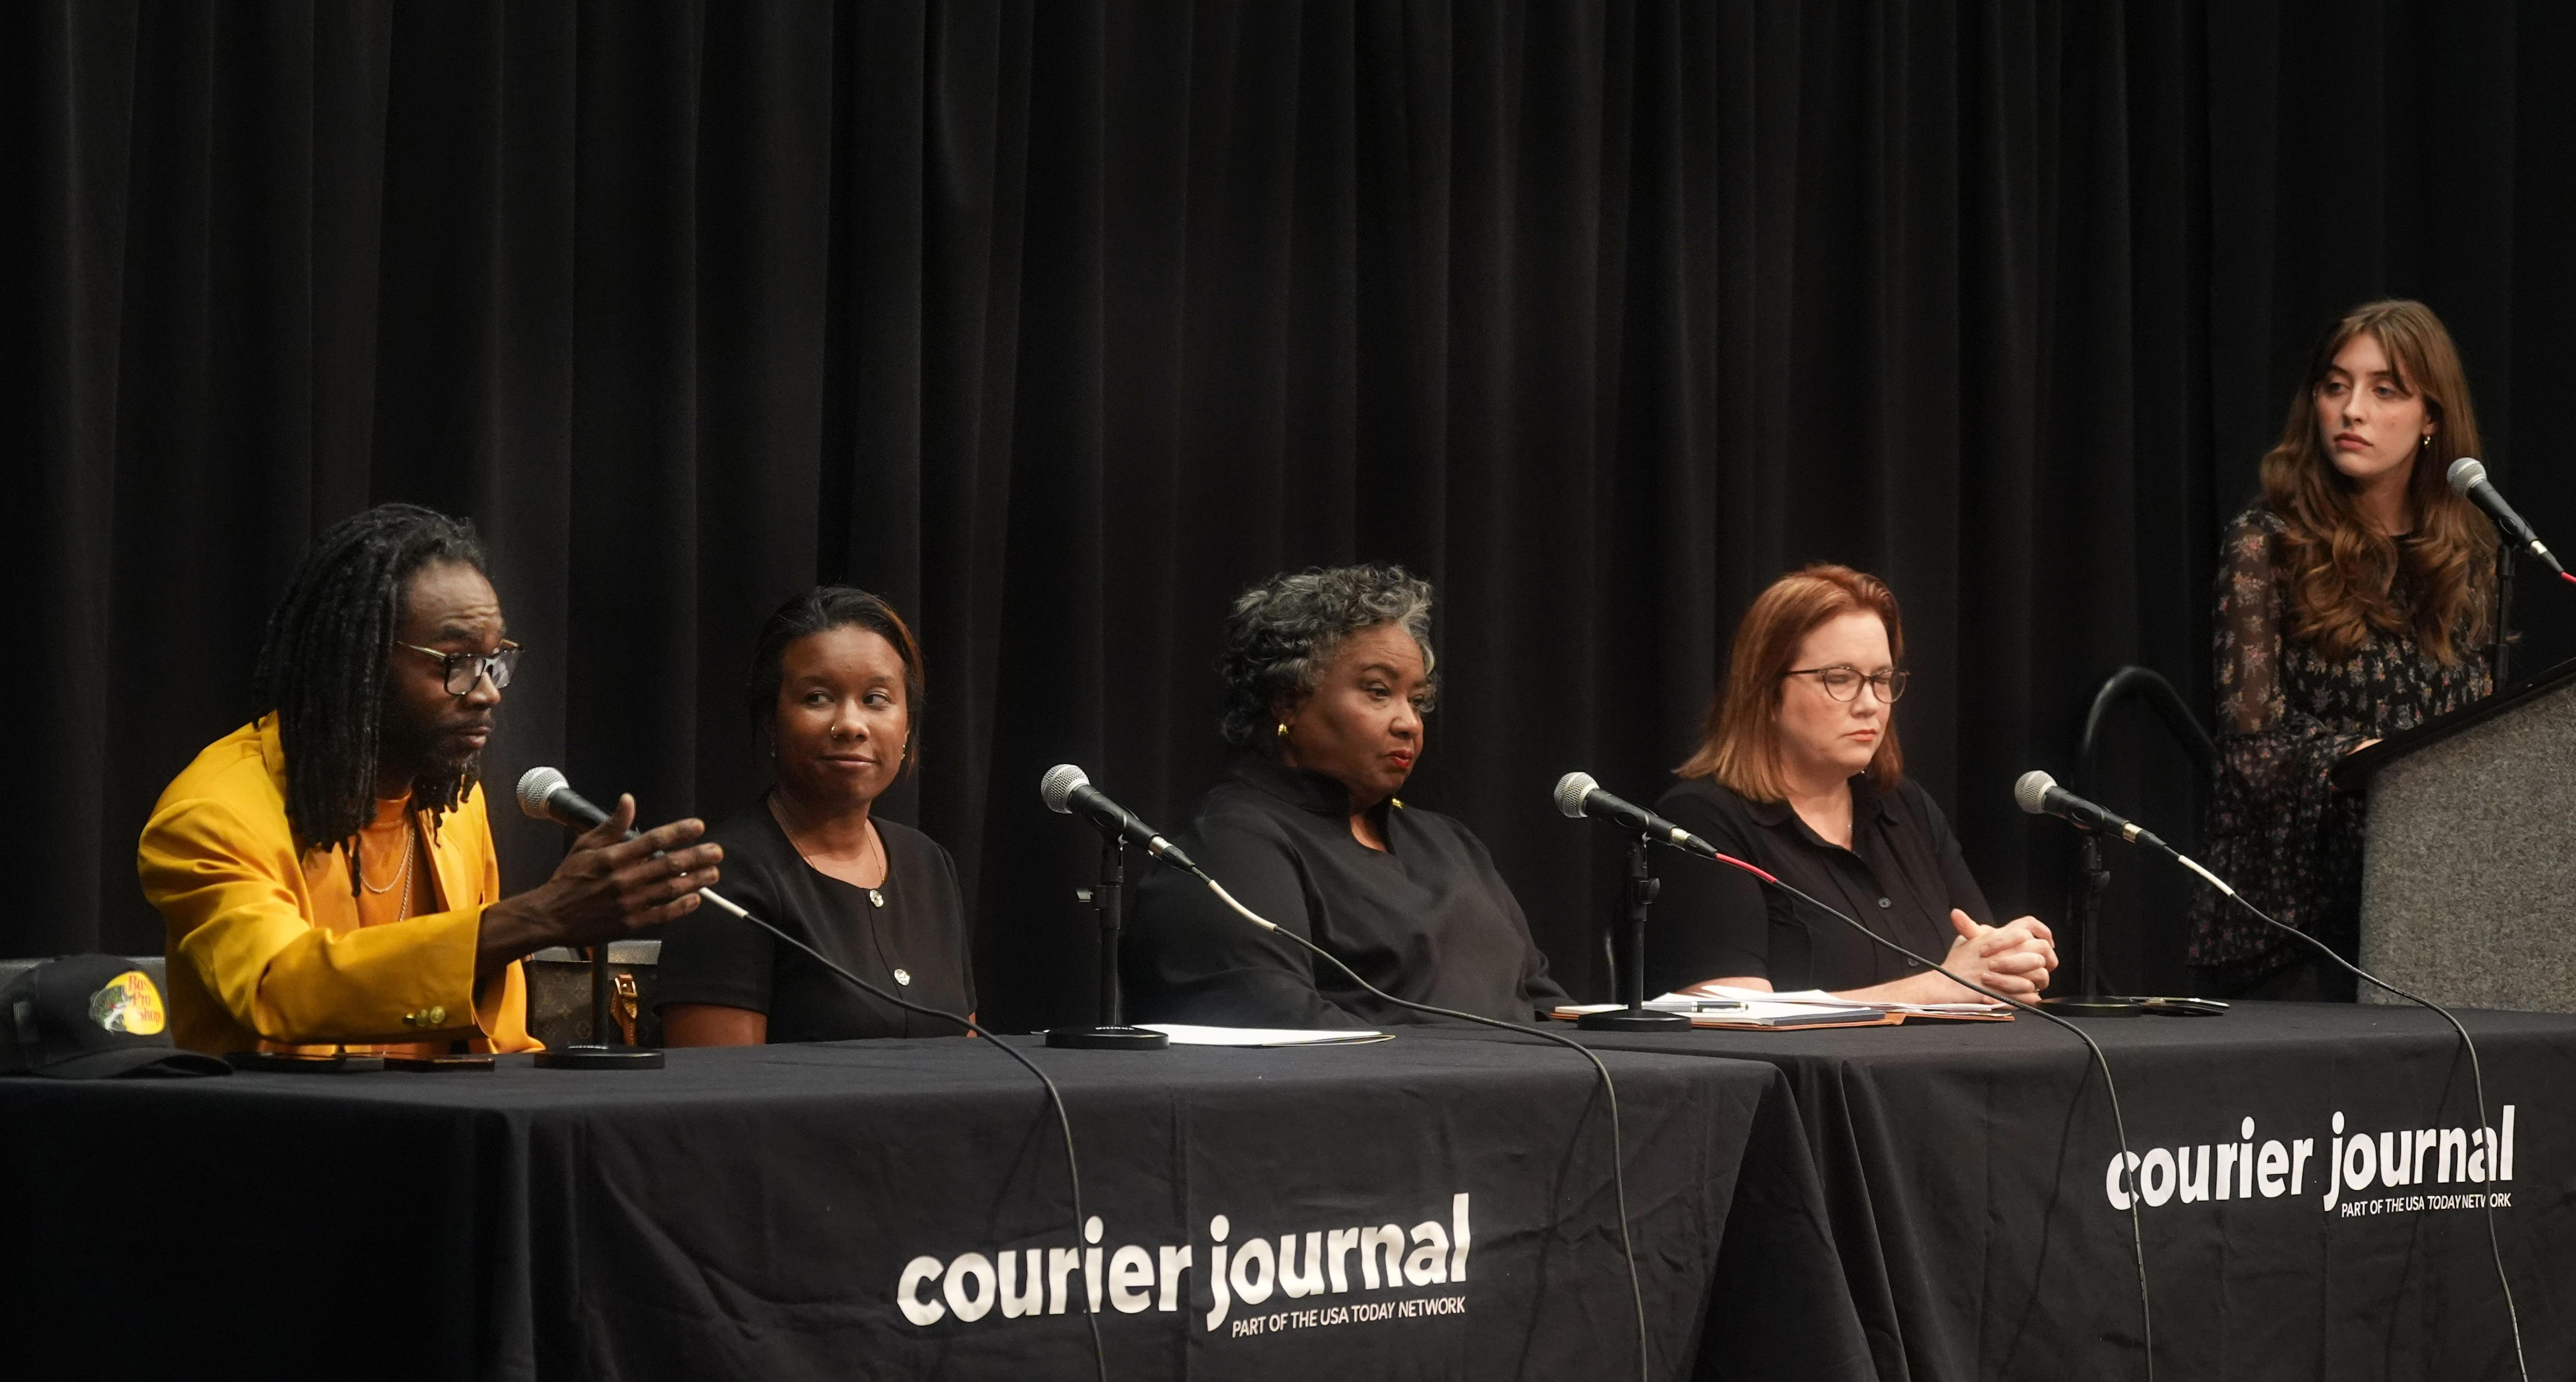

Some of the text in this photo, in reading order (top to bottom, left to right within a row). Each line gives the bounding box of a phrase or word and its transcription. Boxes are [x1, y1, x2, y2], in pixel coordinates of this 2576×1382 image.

[129, 975, 152, 991] Bass
[132, 992, 151, 1007] Pro
[2106, 1105, 2515, 1212] courier journal
[2341, 1201, 2368, 1218] PART
[2369, 1199, 2384, 1215] OF
[2385, 1197, 2405, 1213] THE
[2405, 1196, 2425, 1211] USA
[2427, 1194, 2462, 1210] TODAY
[896, 1192, 1471, 1332] courier journal
[1232, 1296, 1466, 1338] PART OF THE USA TODAY NETWORK
